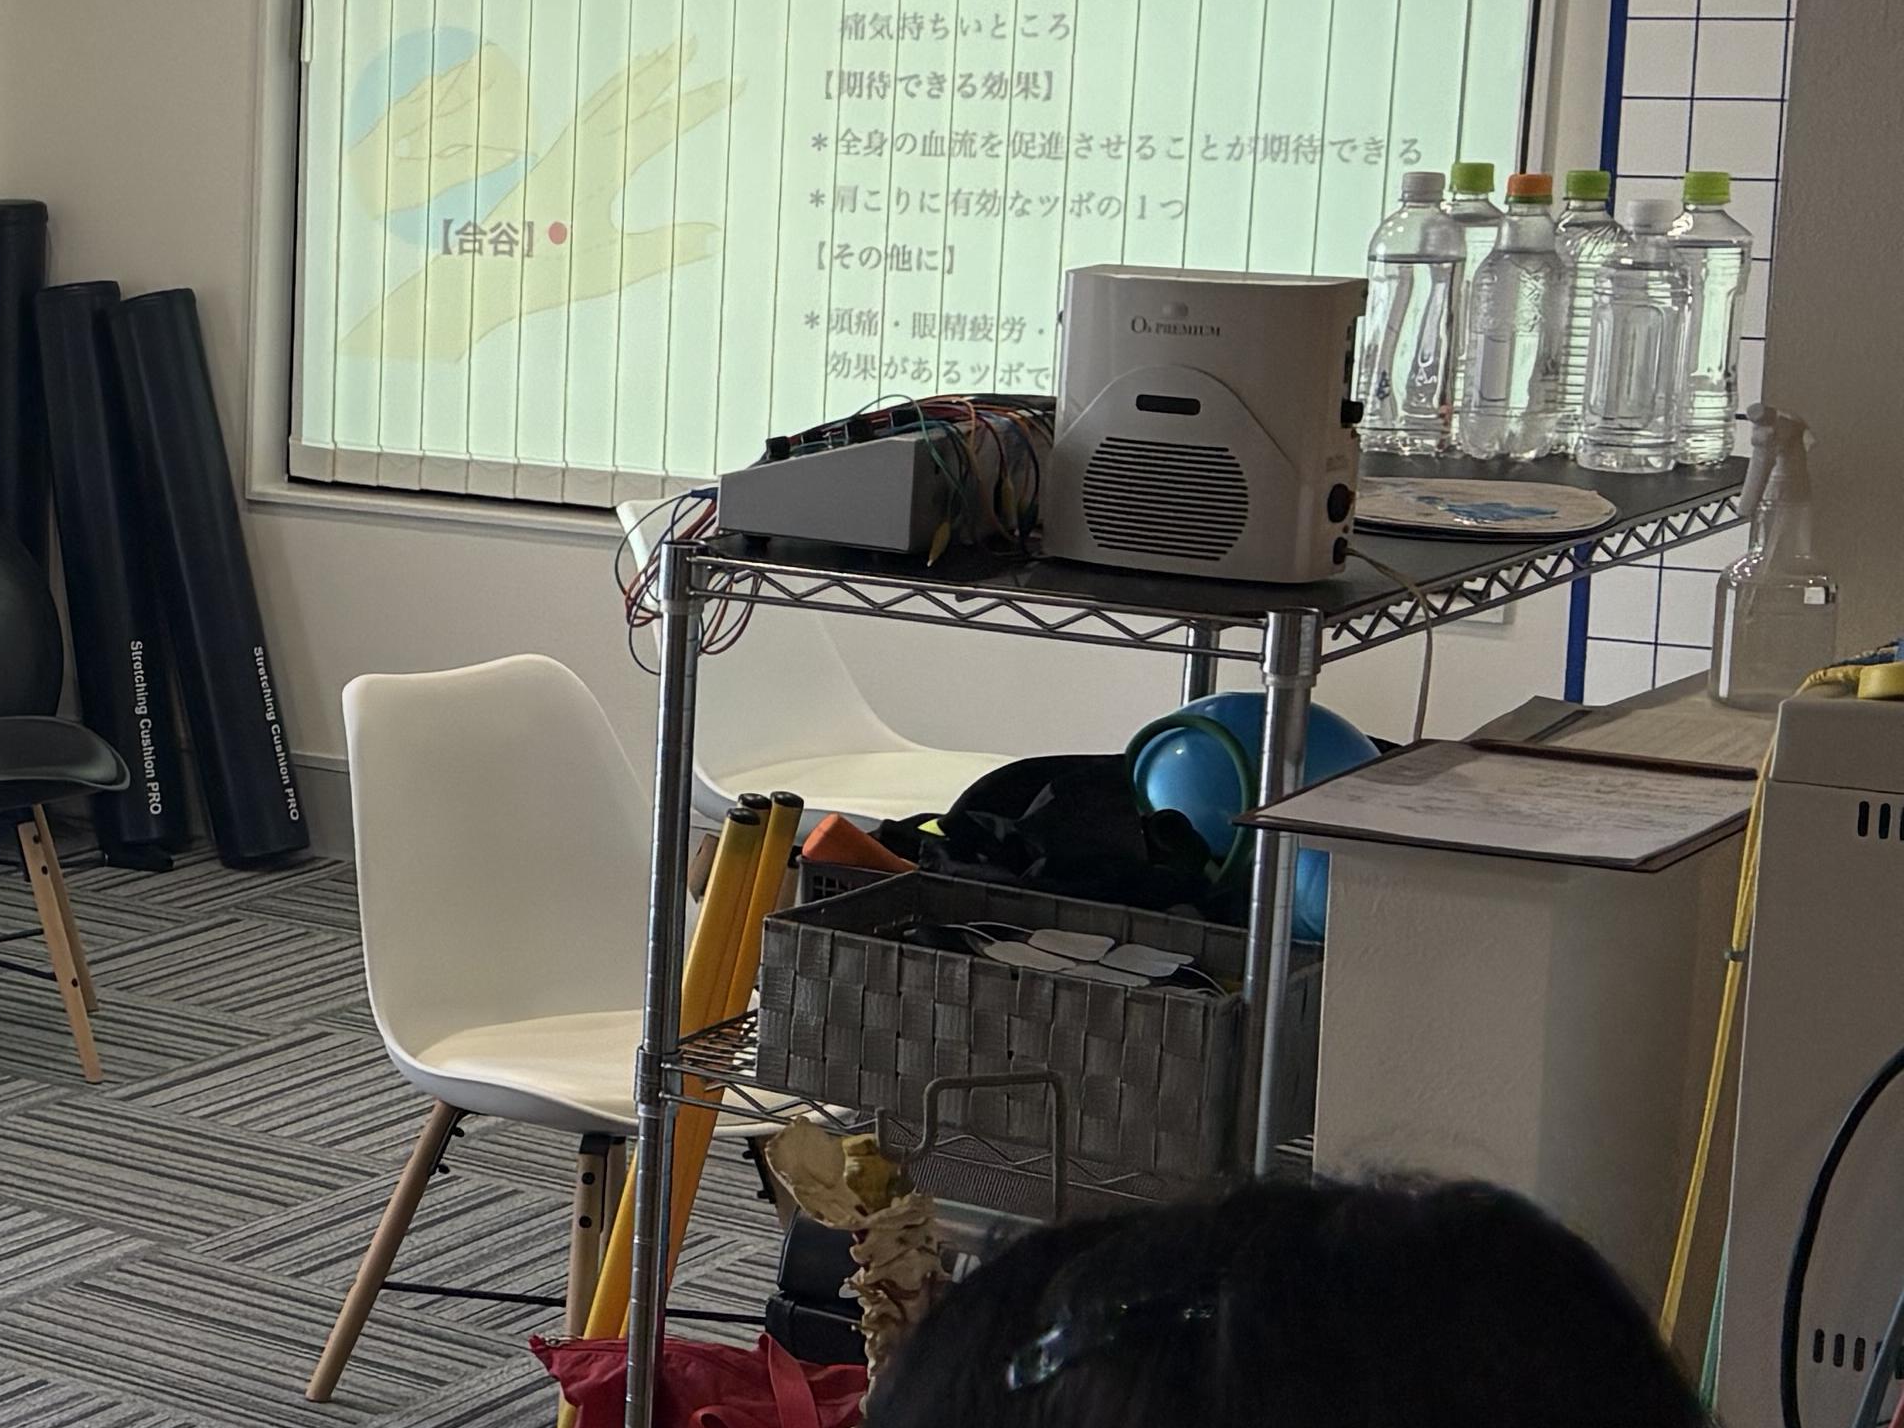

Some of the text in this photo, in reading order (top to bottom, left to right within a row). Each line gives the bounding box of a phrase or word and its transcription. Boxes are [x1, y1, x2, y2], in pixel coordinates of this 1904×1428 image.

[839, 12, 1072, 42] 痛気持ちいところ
[139, 718, 157, 779] Cushion
[271, 723, 290, 785] Cushion
[284, 787, 299, 821] PRO
[147, 781, 162, 815] PRO
